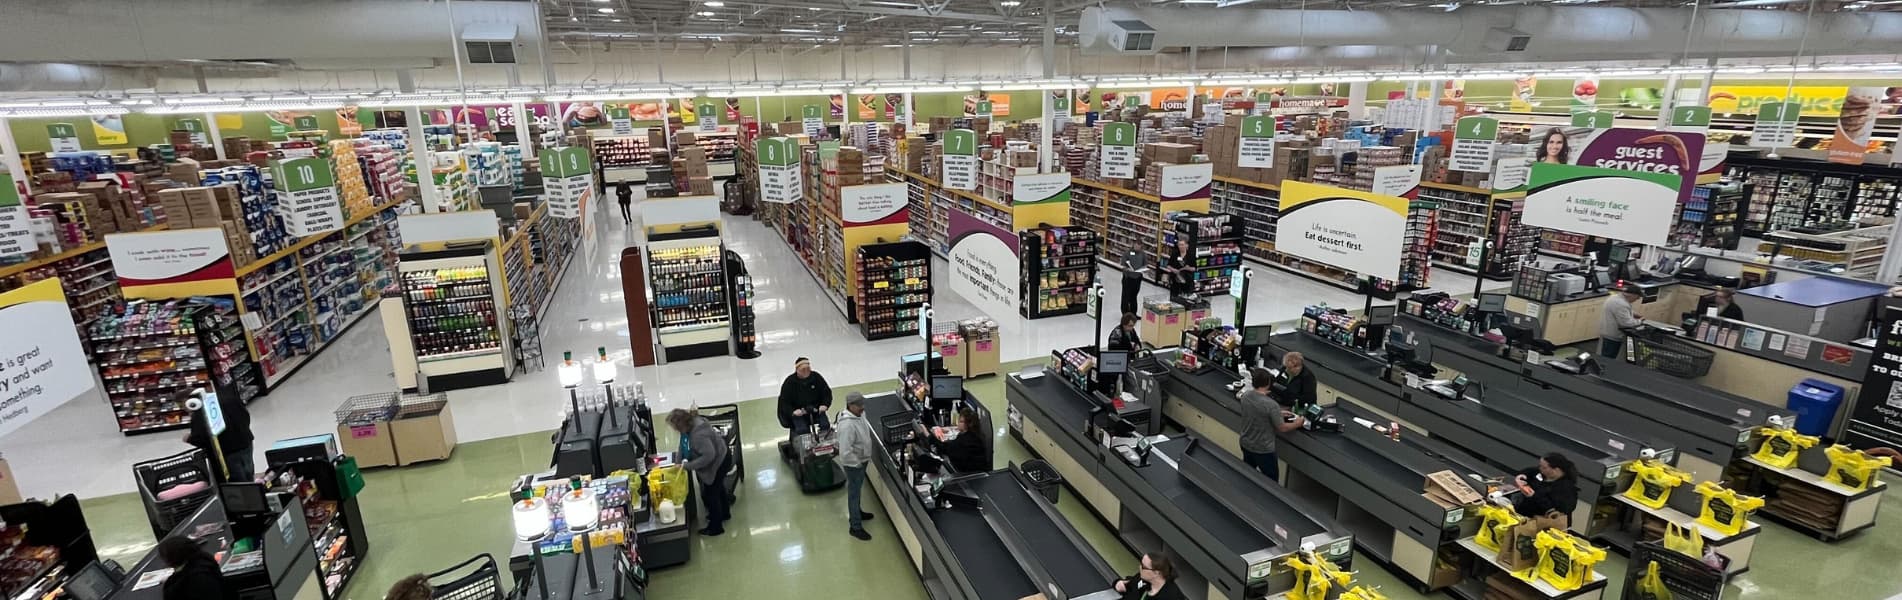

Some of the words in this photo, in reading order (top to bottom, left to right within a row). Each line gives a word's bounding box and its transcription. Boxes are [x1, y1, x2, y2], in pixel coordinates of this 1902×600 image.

[1685, 110, 1694, 122] 2
[1115, 127, 1122, 142] 6
[1255, 120, 1262, 134] 5
[1472, 121, 1481, 136] 4
[955, 135, 962, 151] 7
[768, 144, 775, 161] 8
[1614, 146, 1664, 160] guest
[570, 153, 578, 170] 9
[1595, 158, 1680, 176] services
[296, 165, 315, 185] 10
[1575, 197, 1606, 209] smiling
[1608, 201, 1630, 211] face
[1573, 206, 1589, 215] half
[1590, 208, 1602, 218] the
[1311, 222, 1322, 233] Life
[1304, 231, 1317, 241] Eat
[1317, 234, 1344, 248] dessert
[16, 345, 41, 367] great
[12, 366, 31, 385] and
[31, 358, 54, 375] want
[1872, 364, 1888, 374] TO
[1873, 405, 1900, 418] Apply
